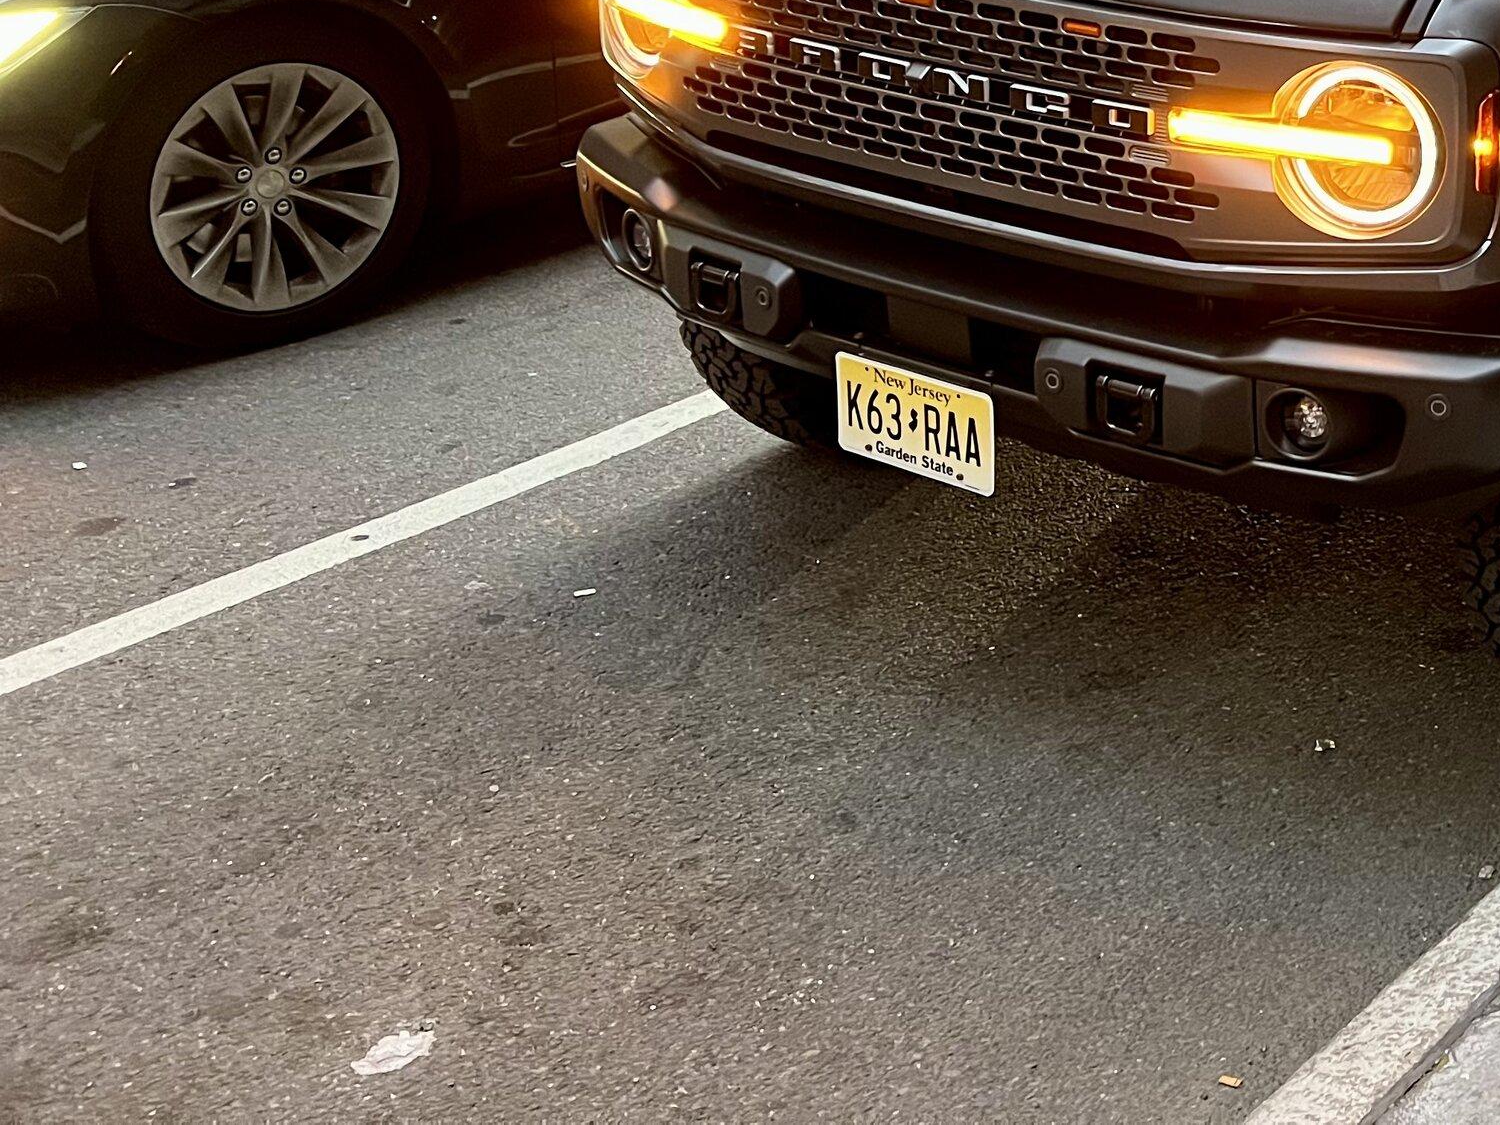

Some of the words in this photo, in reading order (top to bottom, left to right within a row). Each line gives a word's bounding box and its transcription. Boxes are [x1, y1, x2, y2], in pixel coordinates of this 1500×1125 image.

[727, 25, 1155, 136] BRONCO
[874, 367, 906, 390] New
[909, 378, 951, 407] Jersey
[846, 380, 902, 441] K63
[923, 403, 982, 467] RAA
[875, 440, 917, 465] Garden
[921, 455, 954, 476] State
